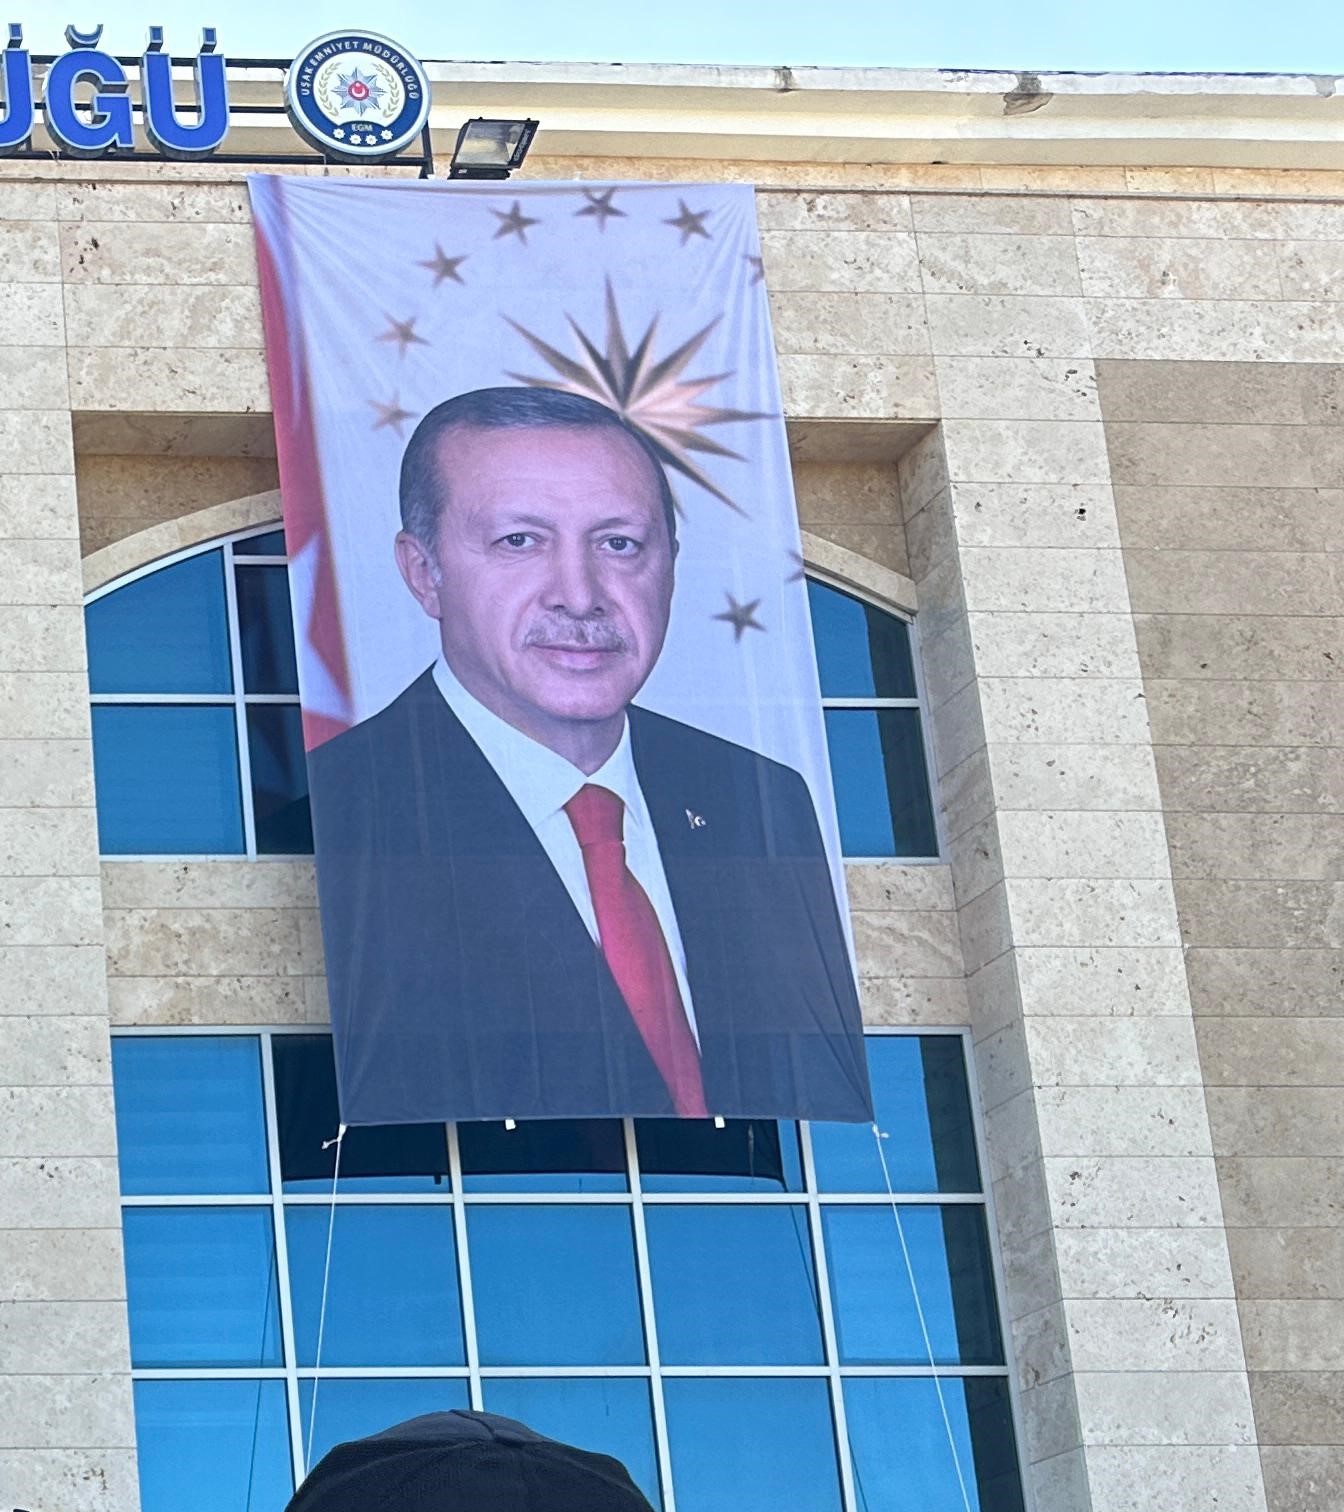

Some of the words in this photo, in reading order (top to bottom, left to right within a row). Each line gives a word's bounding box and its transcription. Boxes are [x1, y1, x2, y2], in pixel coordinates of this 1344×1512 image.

[301, 66, 313, 97] UŞAK
[310, 40, 360, 67] EMNİYET
[361, 40, 420, 100] MÜDÜRLÜĞÜ
